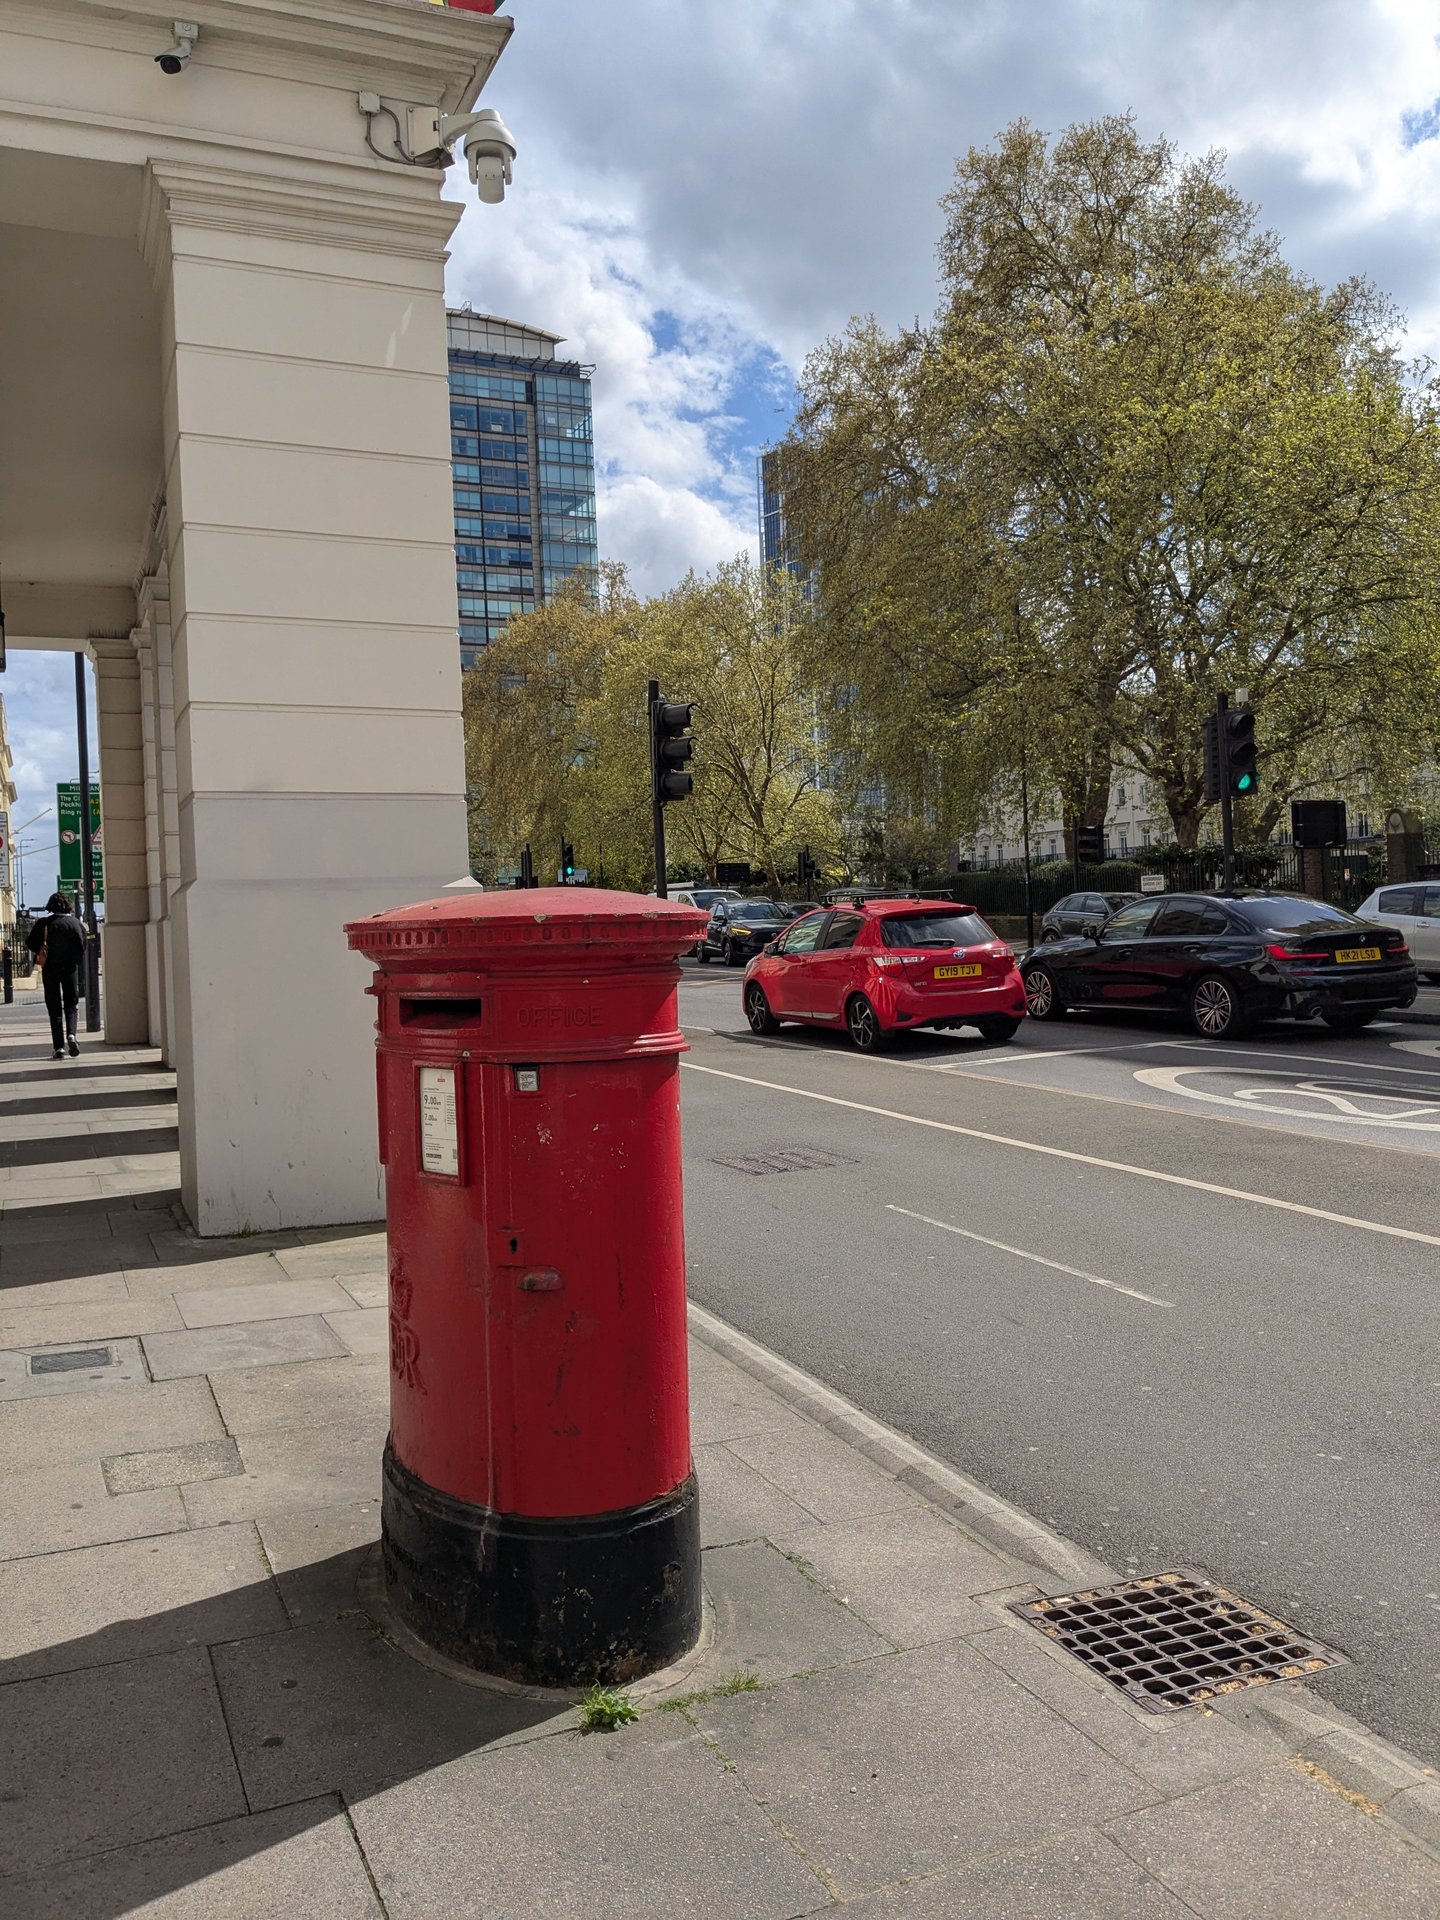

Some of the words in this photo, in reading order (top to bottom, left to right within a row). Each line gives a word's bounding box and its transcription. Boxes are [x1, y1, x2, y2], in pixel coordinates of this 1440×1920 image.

[1340, 951, 1359, 961] HK21
[939, 966, 958, 977] GY19
[960, 964, 976, 975] TJV
[516, 1005, 603, 1027] OFFICE
